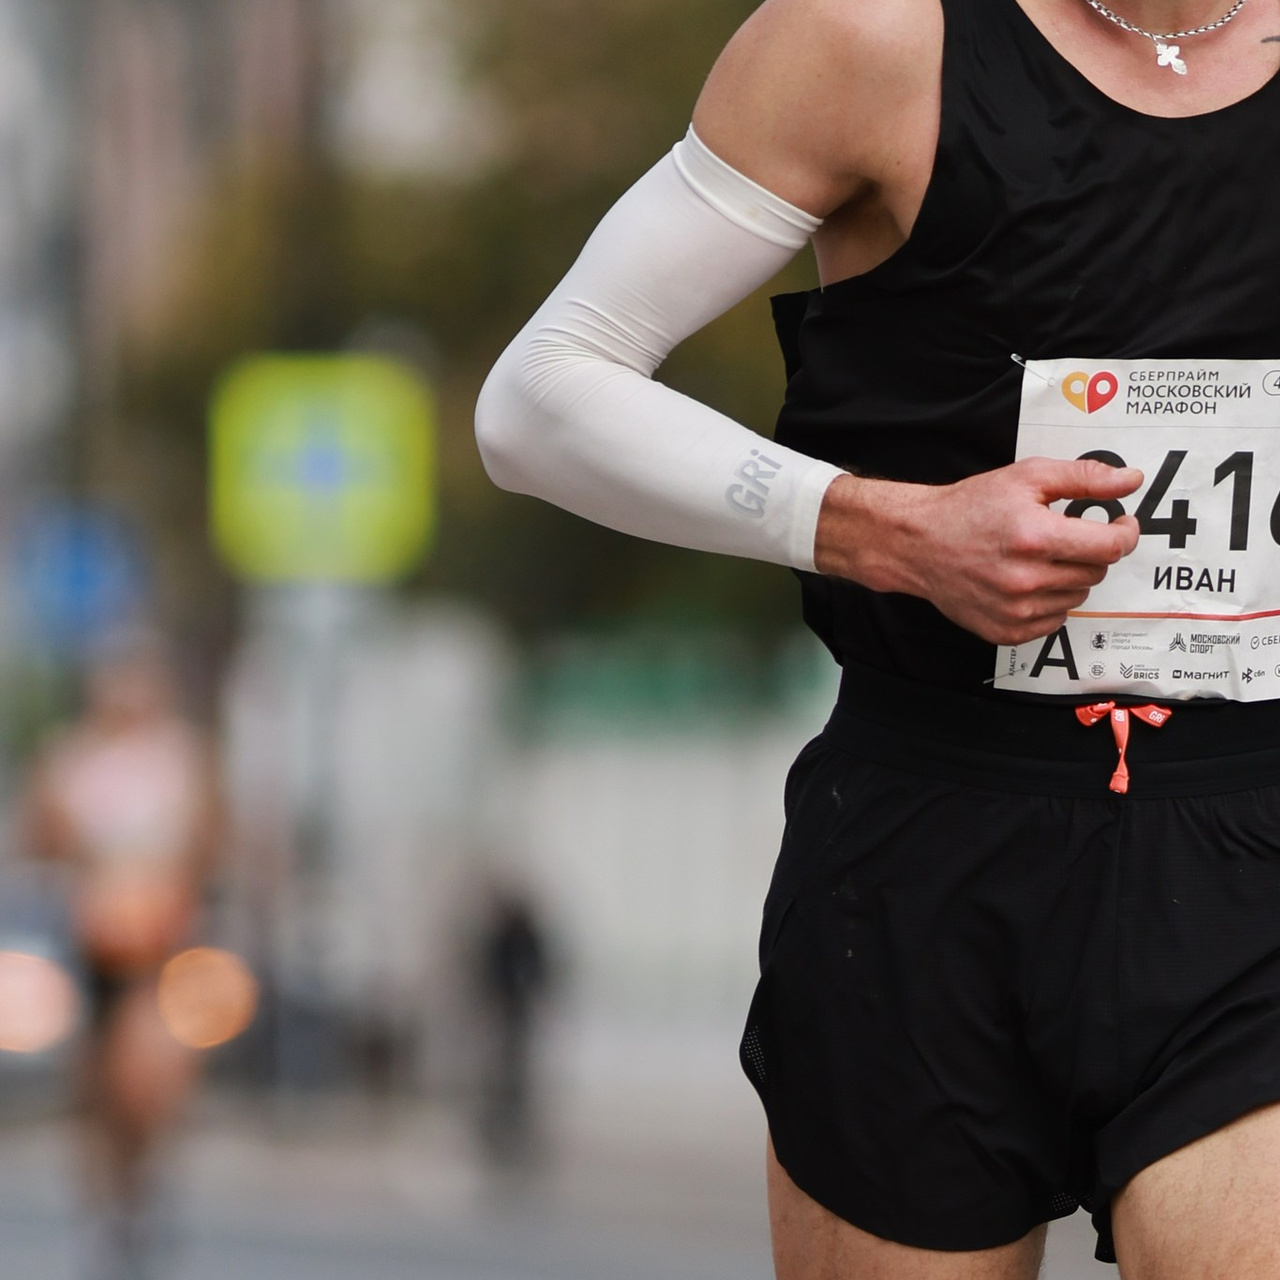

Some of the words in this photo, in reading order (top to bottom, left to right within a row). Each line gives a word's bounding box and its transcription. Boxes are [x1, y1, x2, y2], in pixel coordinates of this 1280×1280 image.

[1129, 369, 1219, 381] СБЕРПРАЙМ
[1128, 382, 1251, 398] МОСКОВСКИЙ
[1126, 401, 1216, 415] МАРАФОН
[725, 449, 782, 518] GRi
[1154, 566, 1235, 593] ИВАН
[1190, 633, 1241, 645] МОСКОВСКИЙ
[1190, 644, 1215, 655] СПОРТ
[1133, 672, 1159, 680] BRICS
[1184, 671, 1230, 680] магнит
